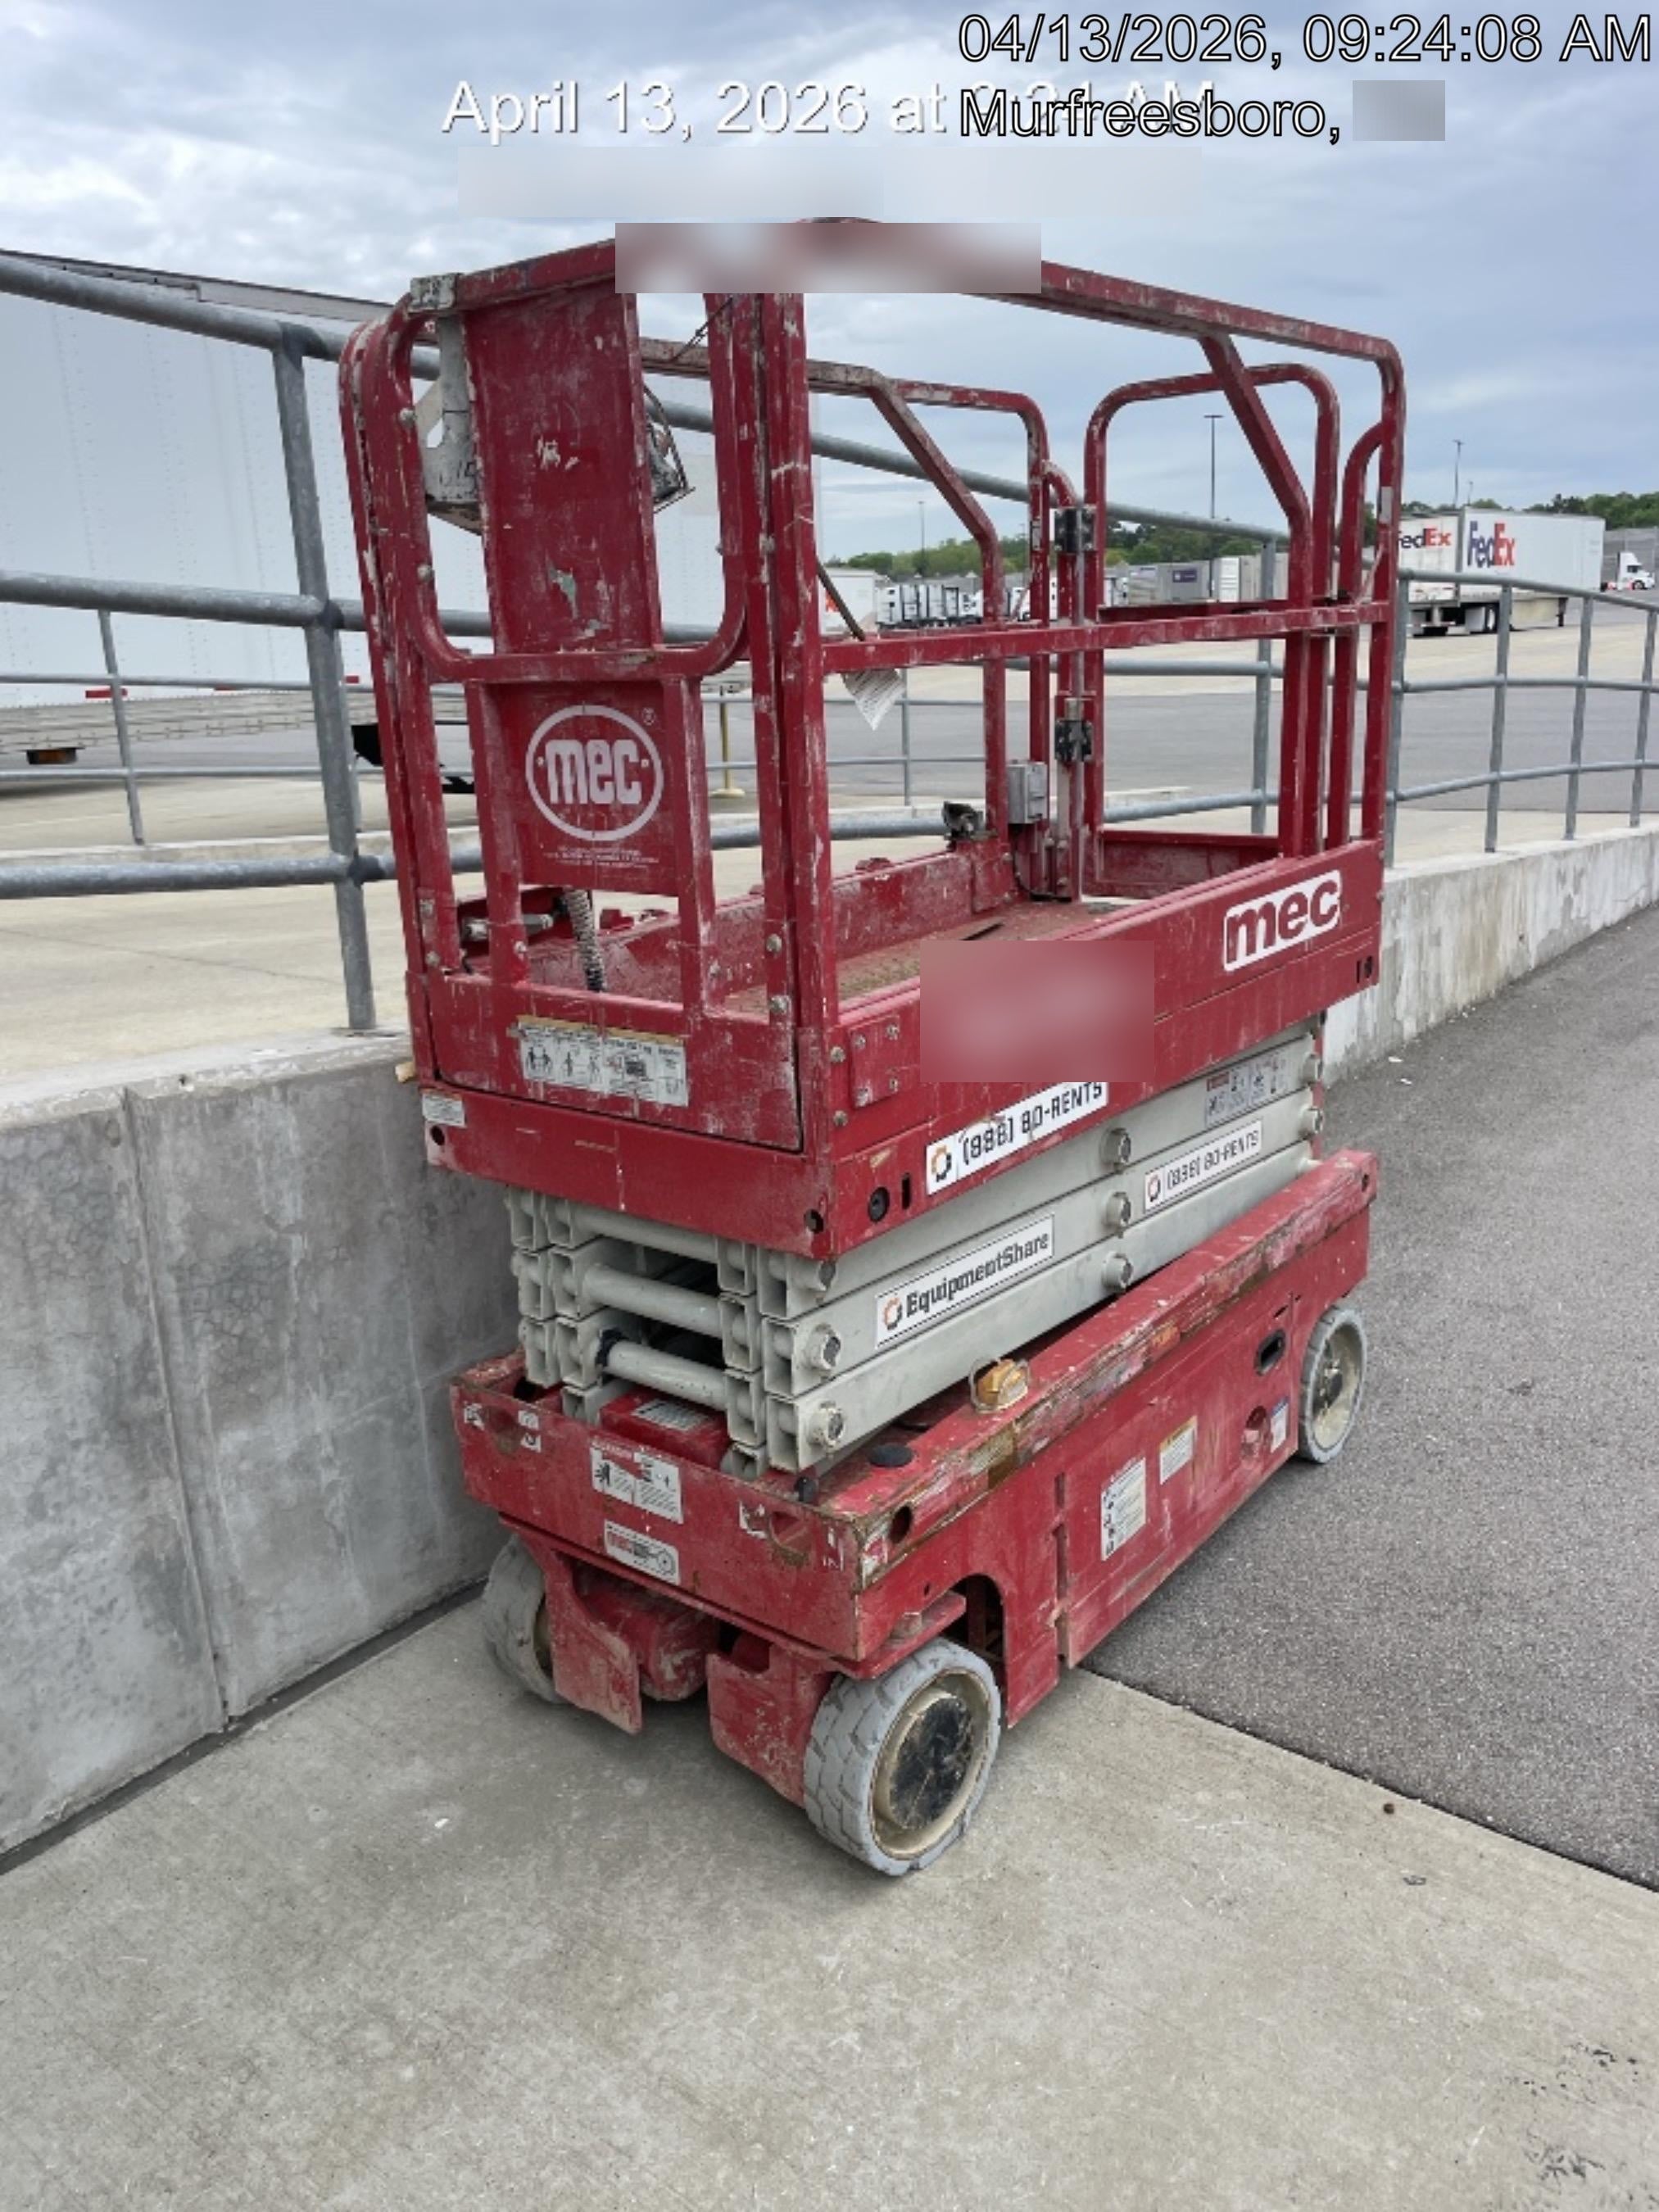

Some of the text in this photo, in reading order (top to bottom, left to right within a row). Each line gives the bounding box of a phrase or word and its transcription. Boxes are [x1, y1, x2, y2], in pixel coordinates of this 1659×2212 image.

[1398, 528, 1452, 548] edEx
[1466, 520, 1516, 568] FedEx
[545, 739, 642, 805] mec
[1226, 879, 1339, 964] mec
[906, 1235, 1049, 1317] EquipmentShare
